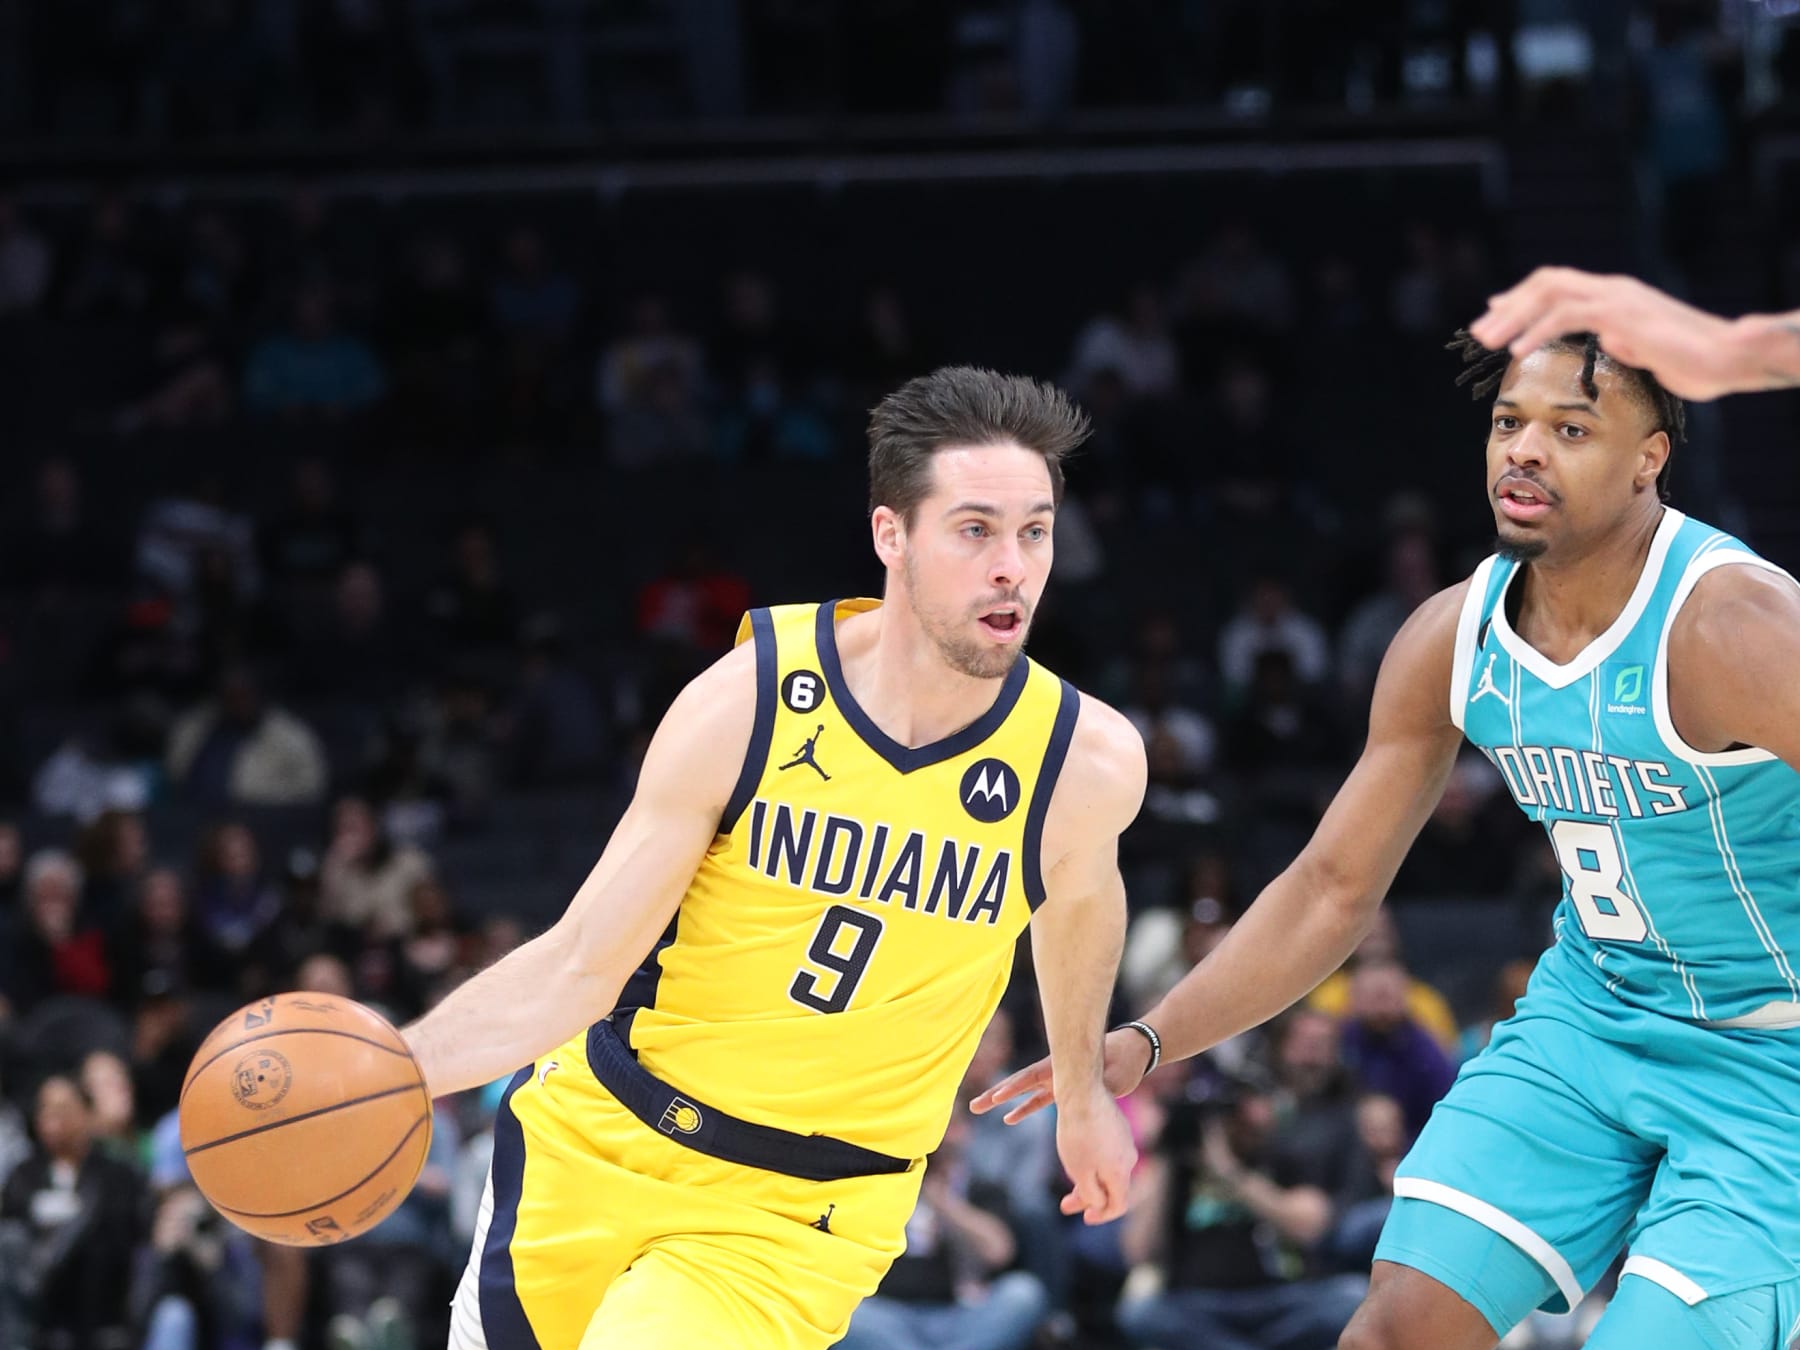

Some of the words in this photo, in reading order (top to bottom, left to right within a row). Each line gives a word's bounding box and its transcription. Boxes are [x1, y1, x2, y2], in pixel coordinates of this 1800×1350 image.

[789, 675, 816, 709] 6
[1479, 746, 1689, 817] ORNETS
[748, 799, 1012, 925] INDIANA
[1550, 820, 1649, 943] 8
[787, 904, 885, 1016] 9
